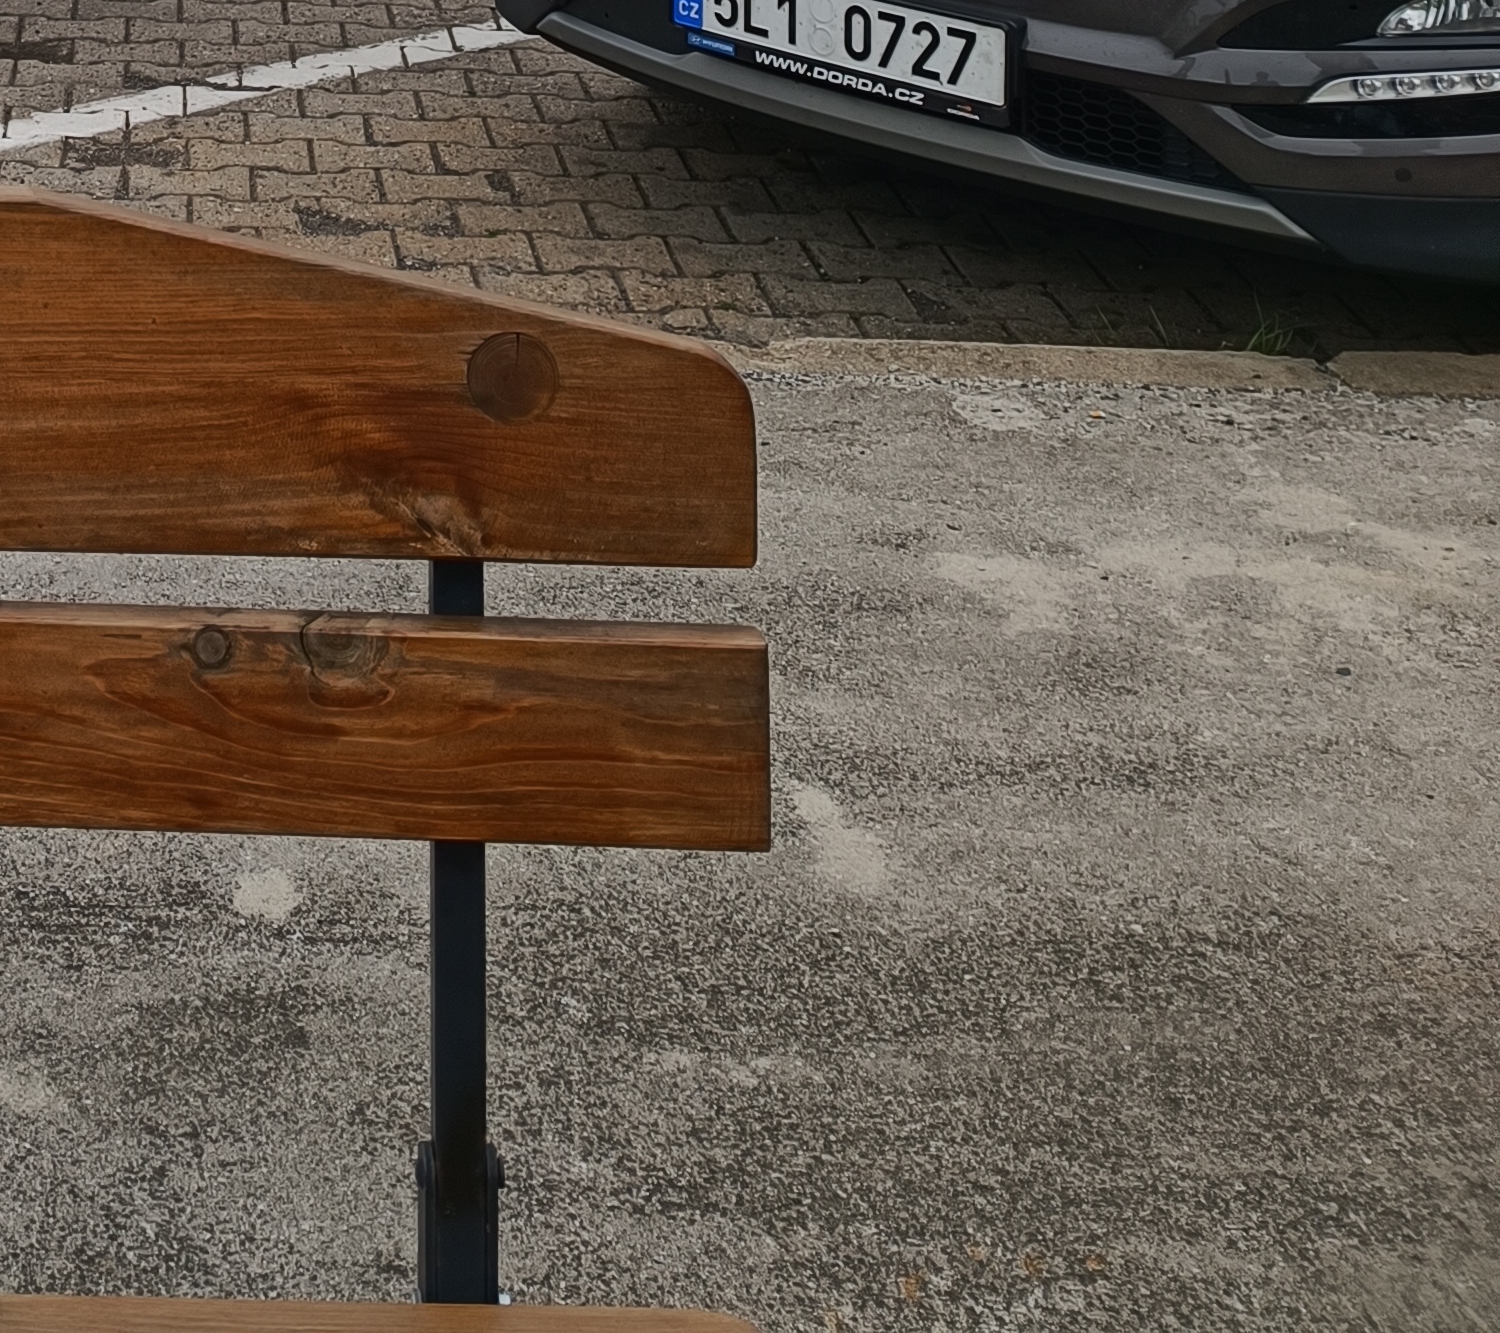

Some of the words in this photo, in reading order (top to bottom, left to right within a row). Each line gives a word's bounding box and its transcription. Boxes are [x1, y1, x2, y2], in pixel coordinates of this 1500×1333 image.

[678, 0, 700, 19] CZ
[844, 4, 977, 86] 0727
[754, 50, 925, 106] WWW.DORDA.CZ
